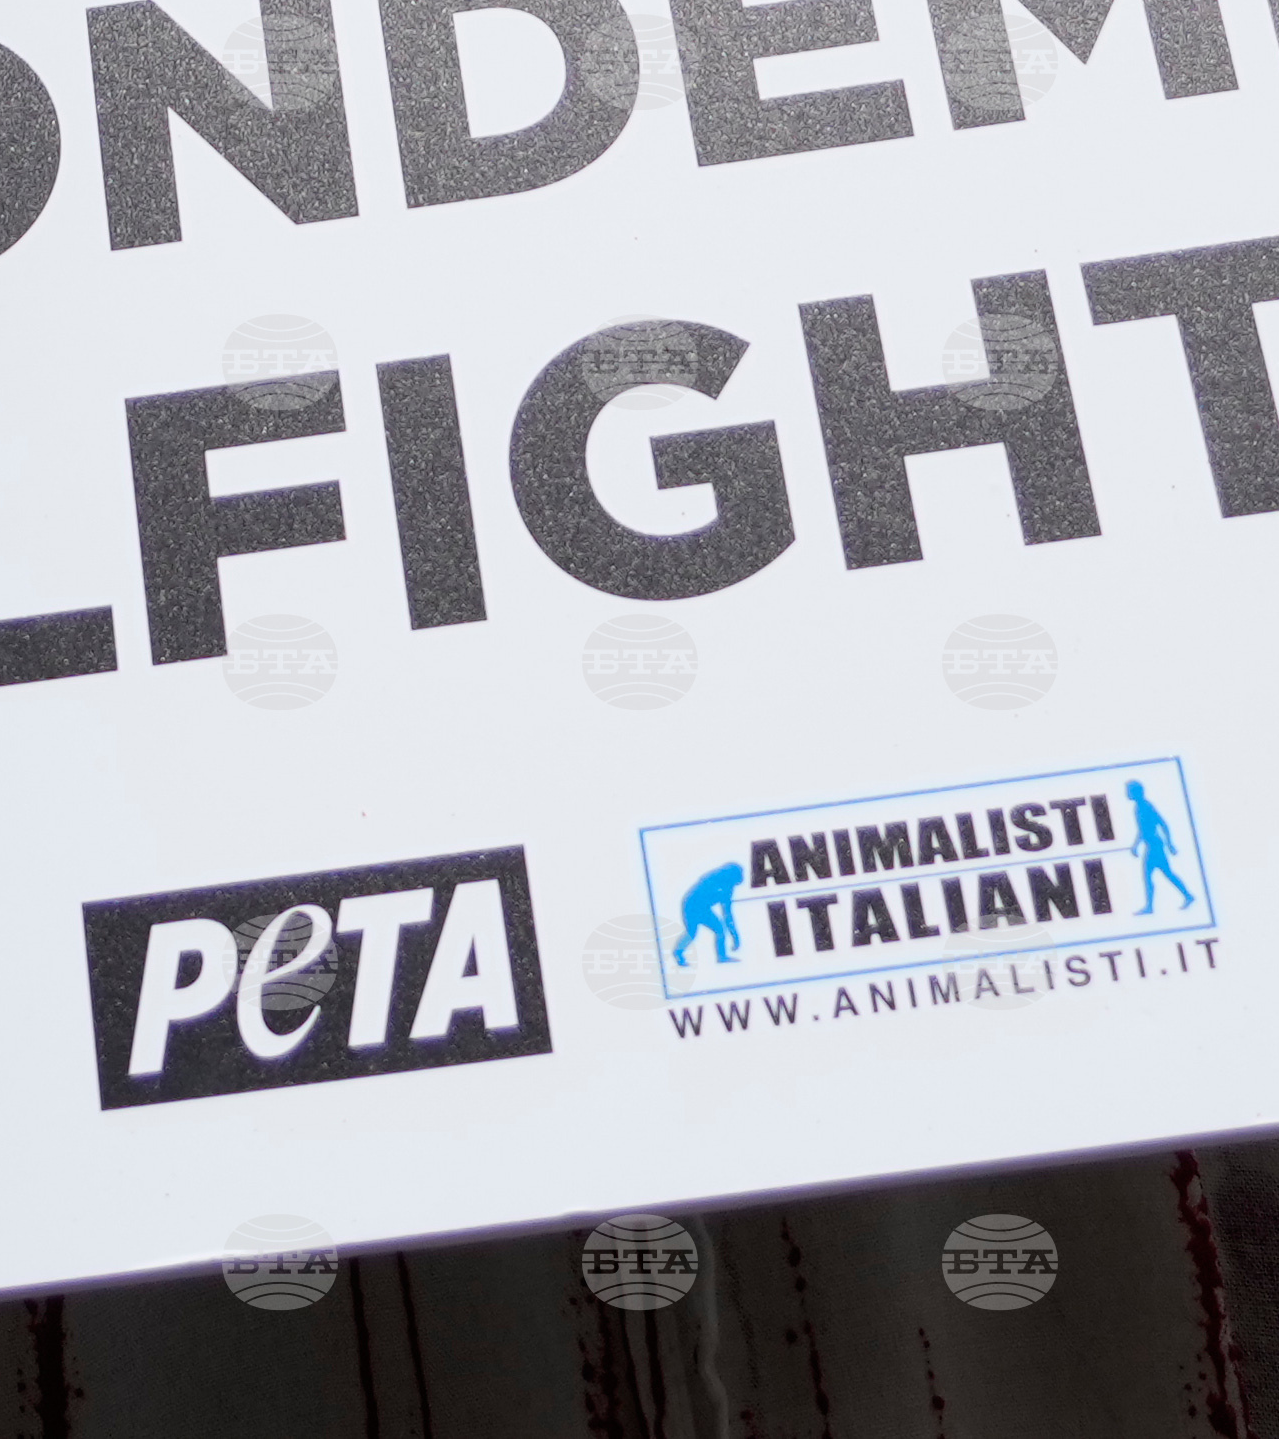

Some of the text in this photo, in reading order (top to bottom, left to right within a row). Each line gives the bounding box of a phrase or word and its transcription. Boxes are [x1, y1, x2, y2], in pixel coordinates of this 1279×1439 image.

[750, 794, 1116, 888] ANIMALISTI
[767, 858, 1113, 957] ITALIANI
[668, 937, 1220, 1040] WWW.ANIMALISTI.IT
